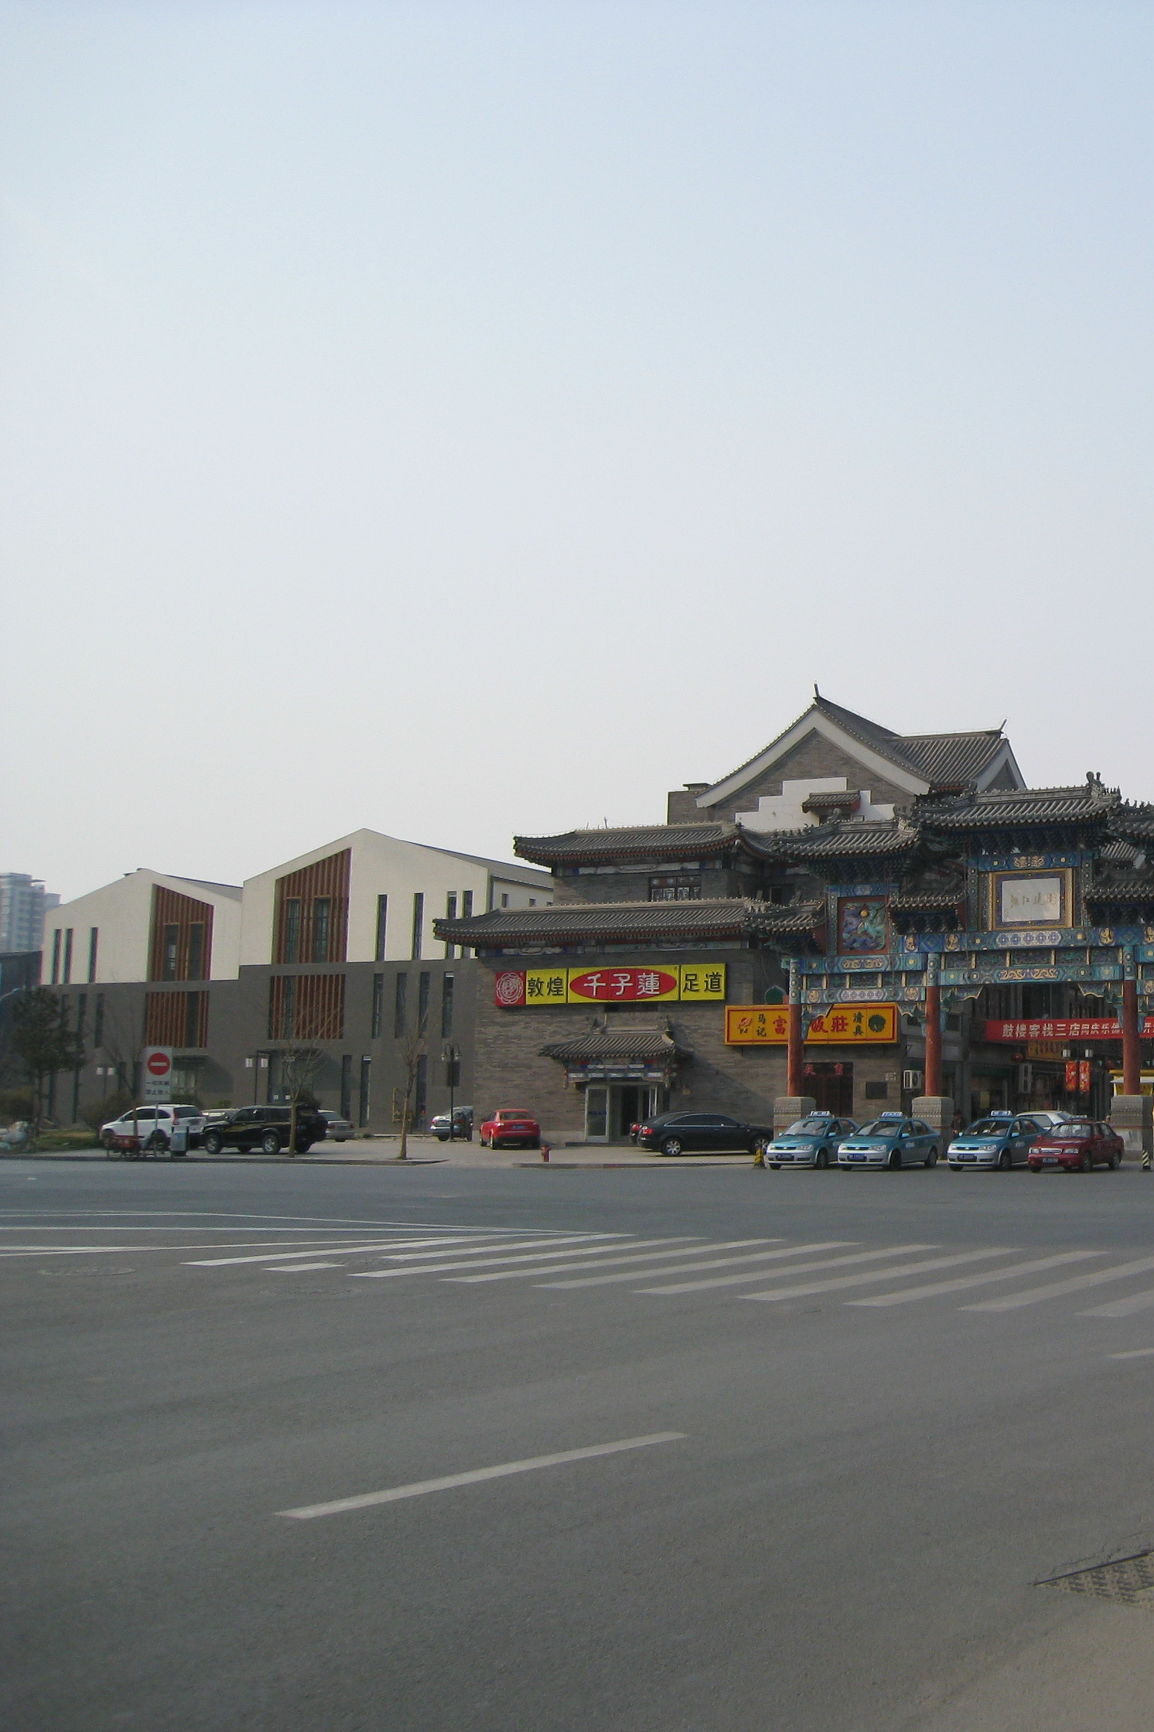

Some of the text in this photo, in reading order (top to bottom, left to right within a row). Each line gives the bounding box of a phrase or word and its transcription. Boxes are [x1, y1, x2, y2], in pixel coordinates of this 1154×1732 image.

[527, 976, 564, 997] 敦煌
[584, 972, 661, 997] 千子蓮
[683, 971, 722, 993] 足道
